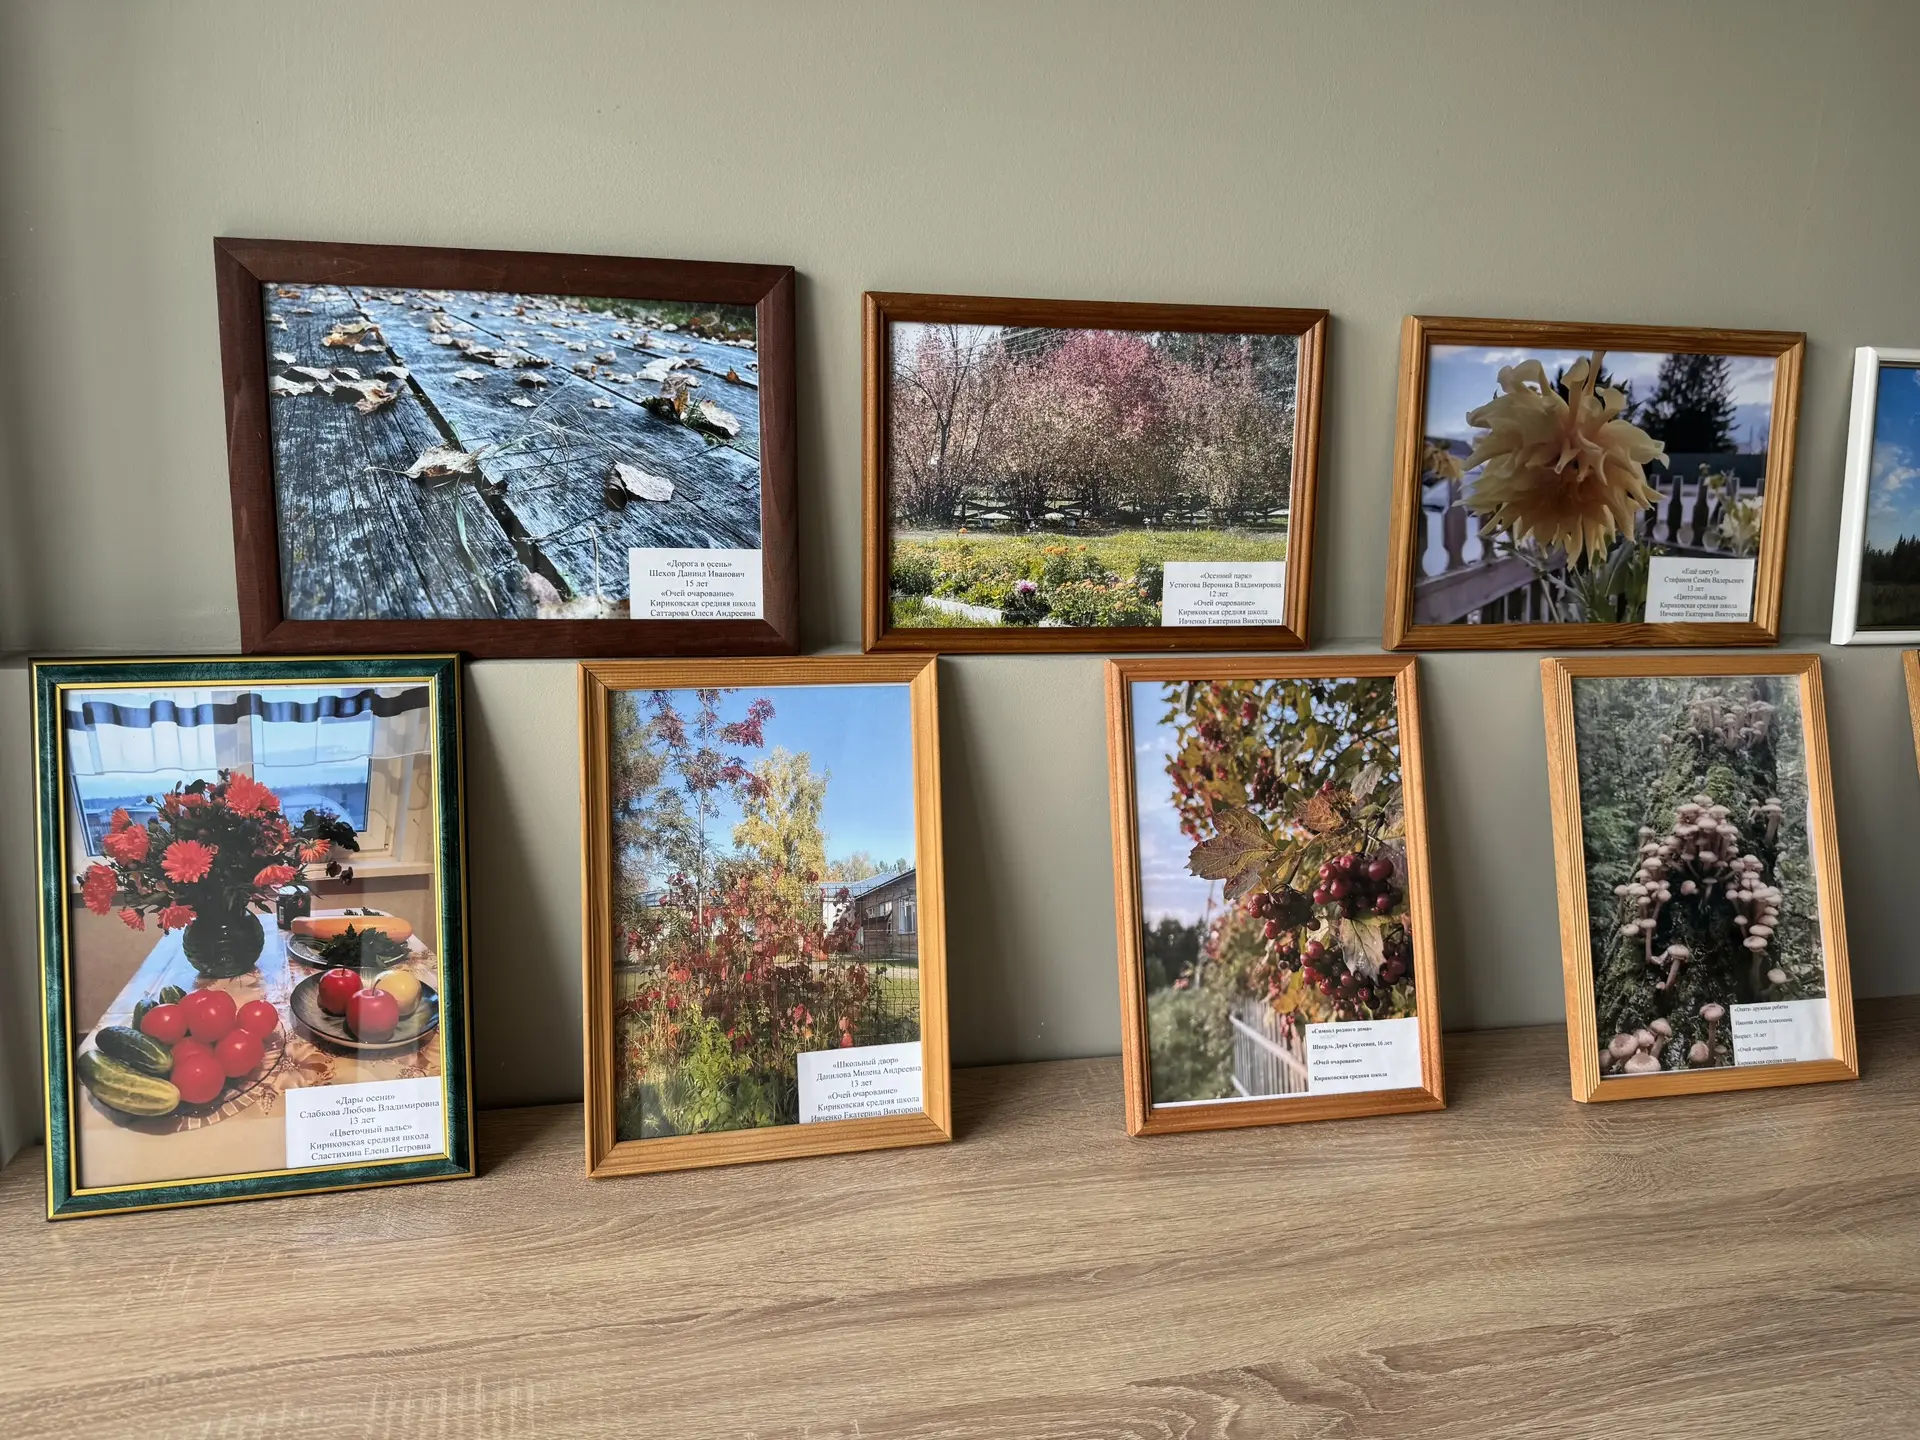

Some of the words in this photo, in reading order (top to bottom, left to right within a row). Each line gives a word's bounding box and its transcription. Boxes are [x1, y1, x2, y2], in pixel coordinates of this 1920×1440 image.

[666, 560, 698, 569] «Дорога
[677, 570, 706, 578] Даниил
[1234, 582, 1281, 590] Владимировна
[650, 599, 699, 608] Кириковская
[650, 610, 689, 618] Саттарова
[1178, 608, 1219, 617] Кириковская
[833, 1058, 876, 1068] «Школьный
[878, 1058, 899, 1066] двор»
[816, 1073, 851, 1082] Данилова
[883, 1065, 921, 1075] Андреевна
[828, 1090, 851, 1100] «Очей
[852, 1088, 898, 1099] очарование»
[336, 1096, 363, 1105] «Дары
[817, 1102, 865, 1112] Кириковская
[866, 1098, 894, 1108] средняя
[299, 1110, 341, 1119] Слабкова
[342, 1105, 376, 1115] Любовь
[378, 1100, 439, 1112] Владимировна
[883, 1106, 923, 1115] Викторовн
[349, 1117, 359, 1125] 13
[329, 1126, 382, 1138] «Цветочный
[310, 1139, 365, 1151] Кириковская
[367, 1136, 400, 1145] средняя
[311, 1150, 362, 1161] Сластихина
[391, 1144, 431, 1154] Петровна
